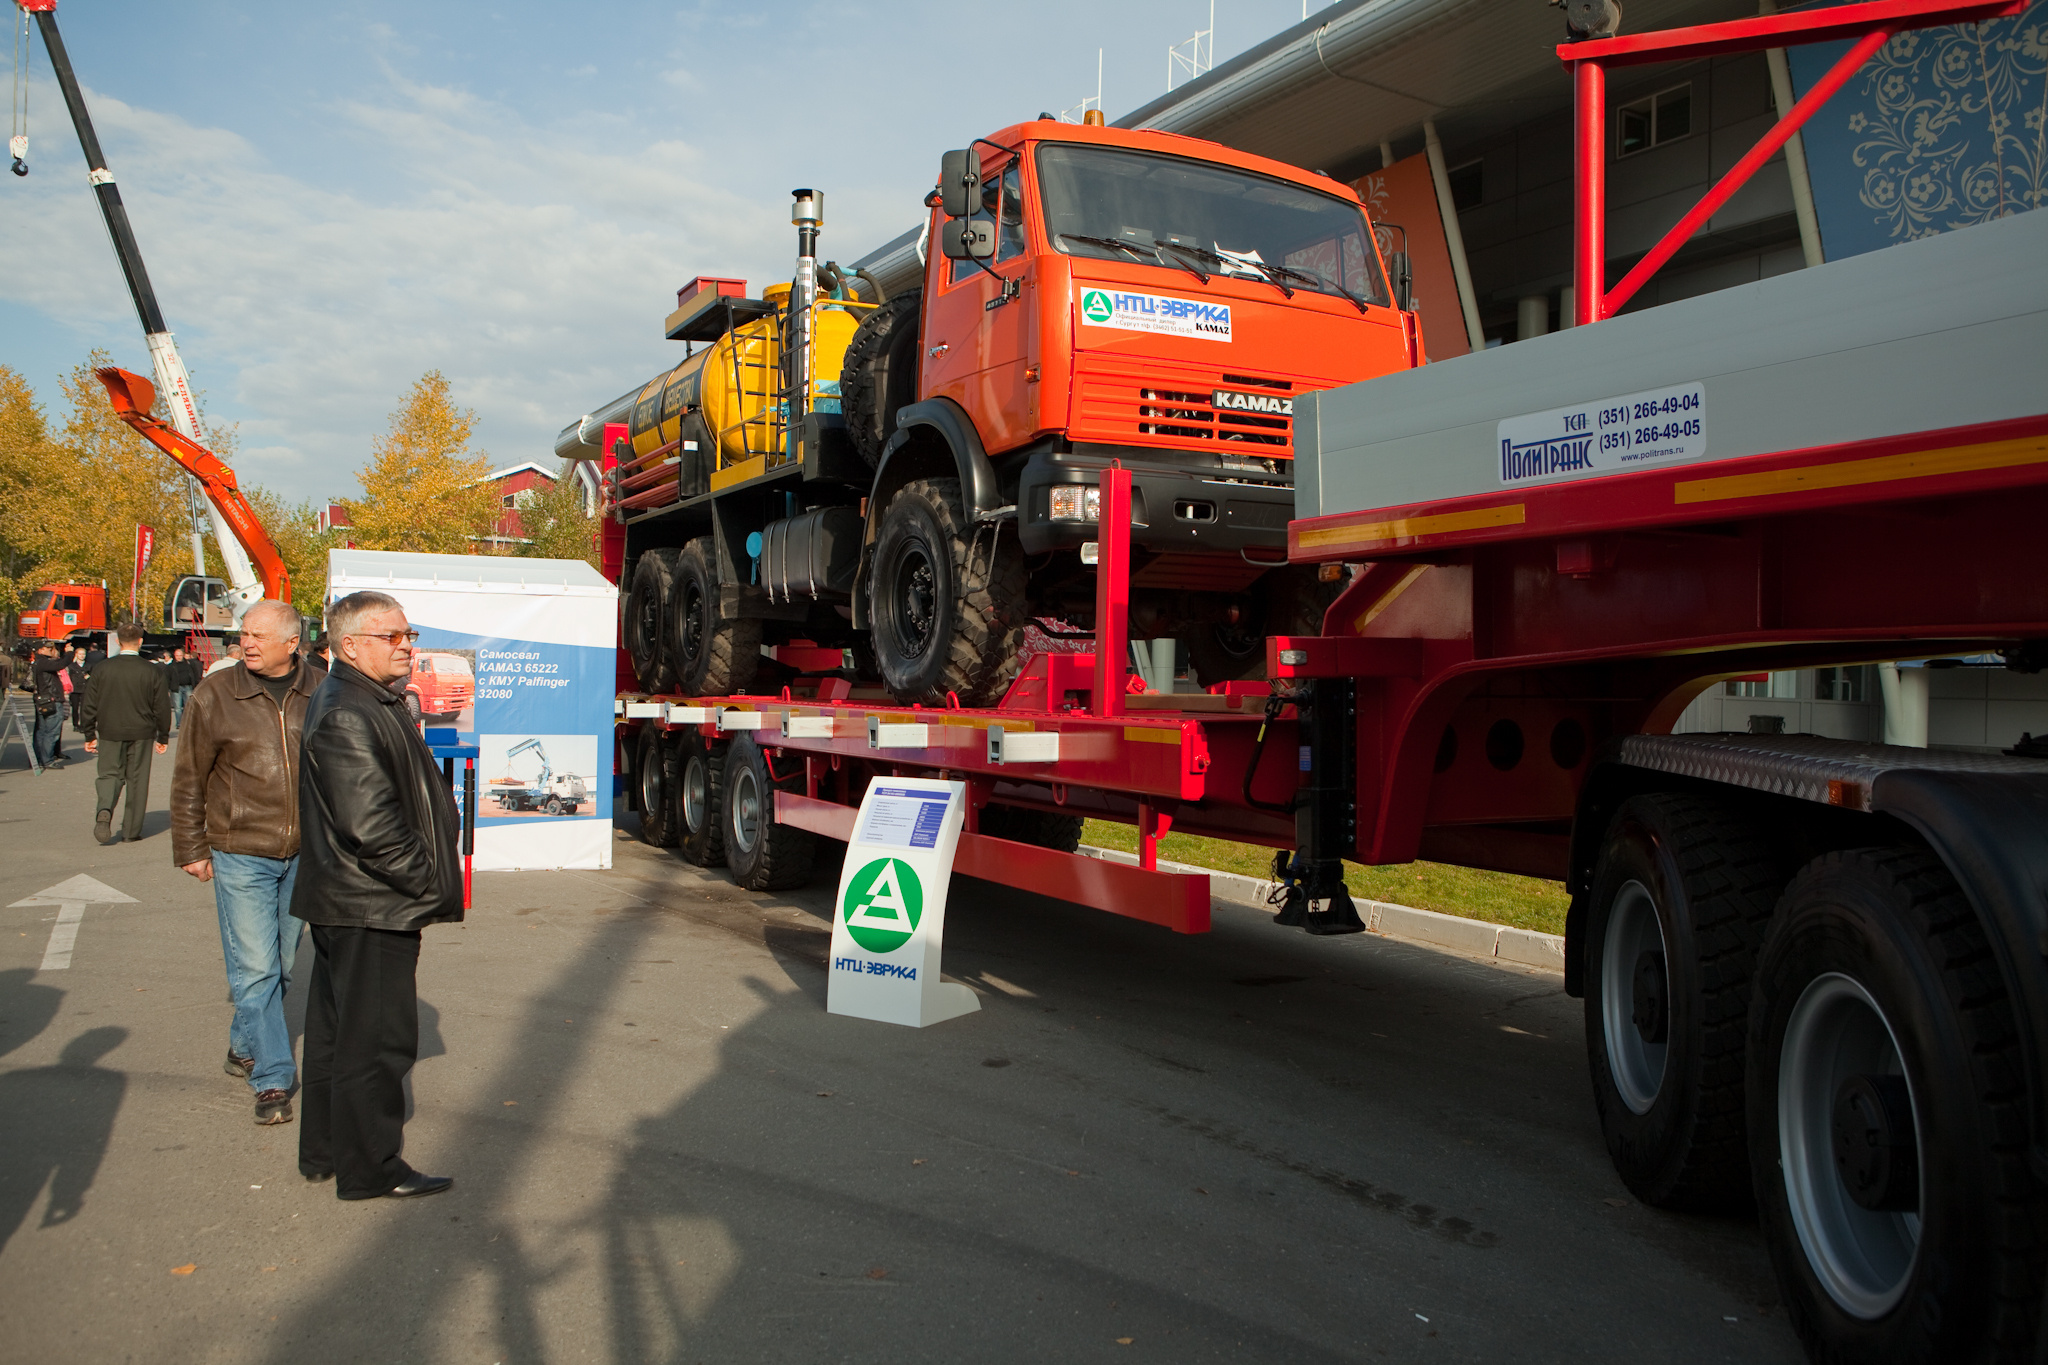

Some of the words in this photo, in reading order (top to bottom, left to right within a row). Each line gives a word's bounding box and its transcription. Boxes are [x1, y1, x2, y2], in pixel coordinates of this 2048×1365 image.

[1196, 322, 1229, 335] KAMAZ
[176, 377, 202, 438] ЧЕЛЯБИНЕЦ
[1216, 391, 1293, 415] KAMAZ
[1598, 405, 1630, 429] (351)
[1634, 392, 1700, 420] 266-49-04
[1599, 430, 1631, 454] (351)
[1635, 419, 1701, 445] 266-49-05
[1620, 446, 1684, 462] www.politrans.ru
[224, 499, 249, 531] HITACHI
[479, 648, 540, 660] Самосвал
[478, 662, 522, 672] КАМАЗ
[524, 663, 559, 674] 65222
[478, 677, 486, 686] с
[488, 675, 516, 686] КМУ
[517, 676, 570, 689] Palfinger
[478, 689, 513, 699] 32080
